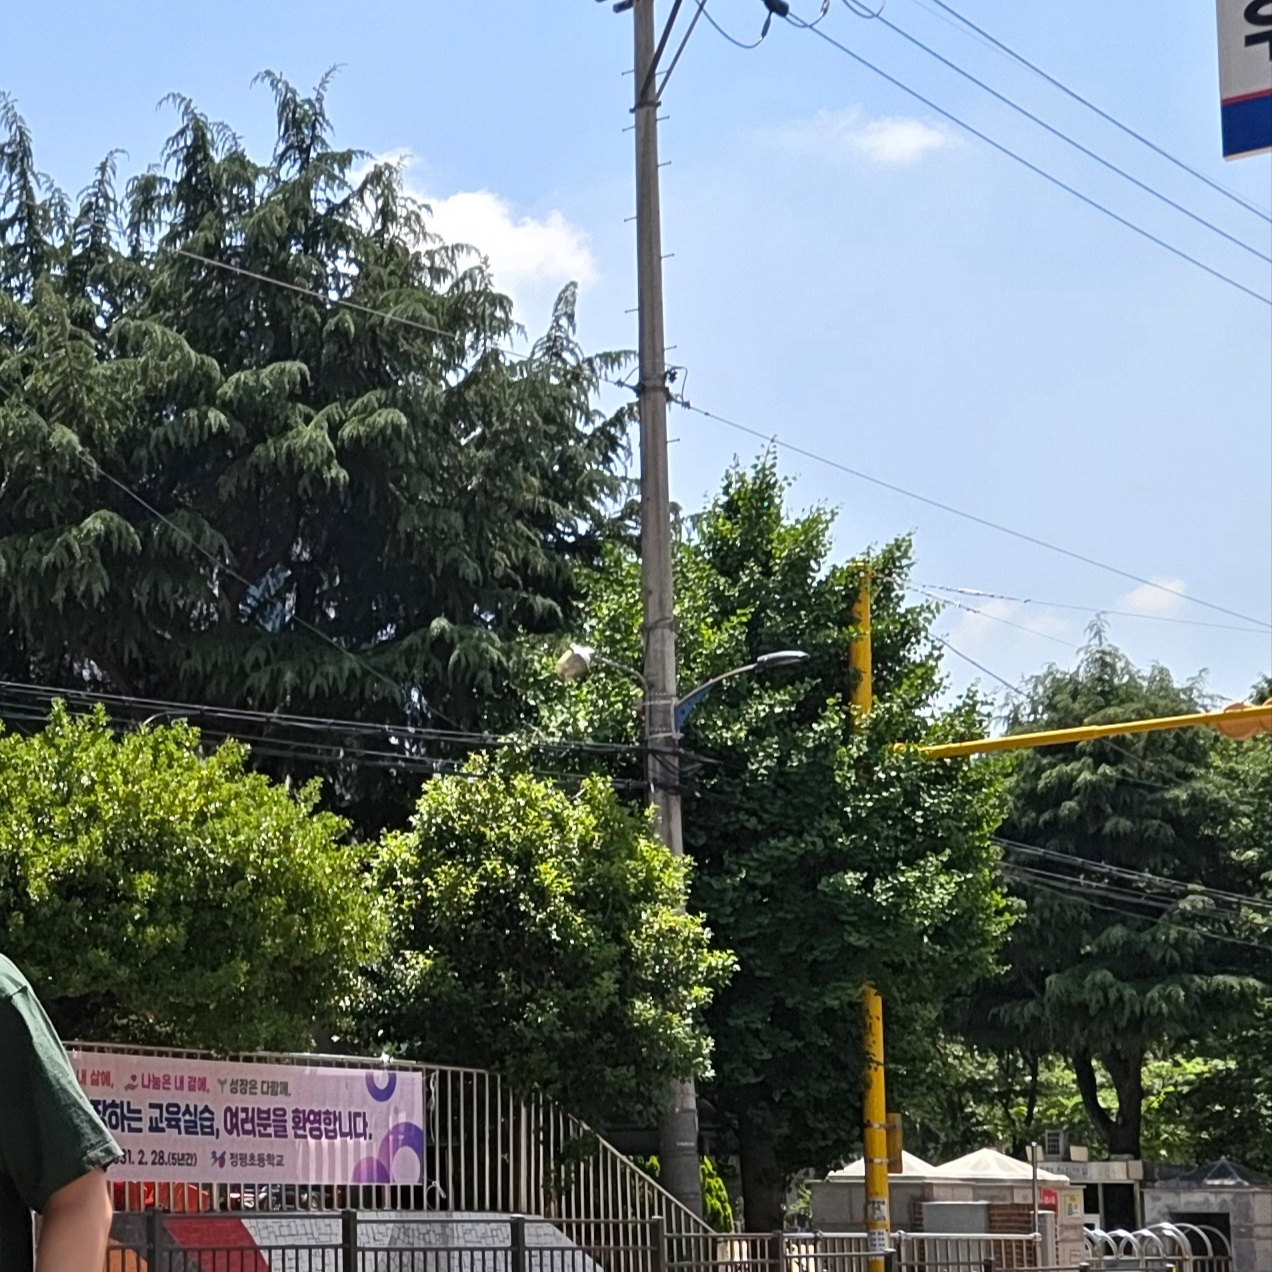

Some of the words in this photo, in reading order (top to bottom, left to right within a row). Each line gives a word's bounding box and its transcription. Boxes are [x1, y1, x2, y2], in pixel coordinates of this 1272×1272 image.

[141, 1073, 172, 1091] 나눔은
[175, 1075, 184, 1091] 내
[230, 1079, 258, 1096] 성장은
[148, 1102, 220, 1140] 교육실습,
[223, 1106, 288, 1139] 여러분을
[291, 1108, 373, 1141] 환영합니다.
[229, 1152, 285, 1168] 정평초등학교
